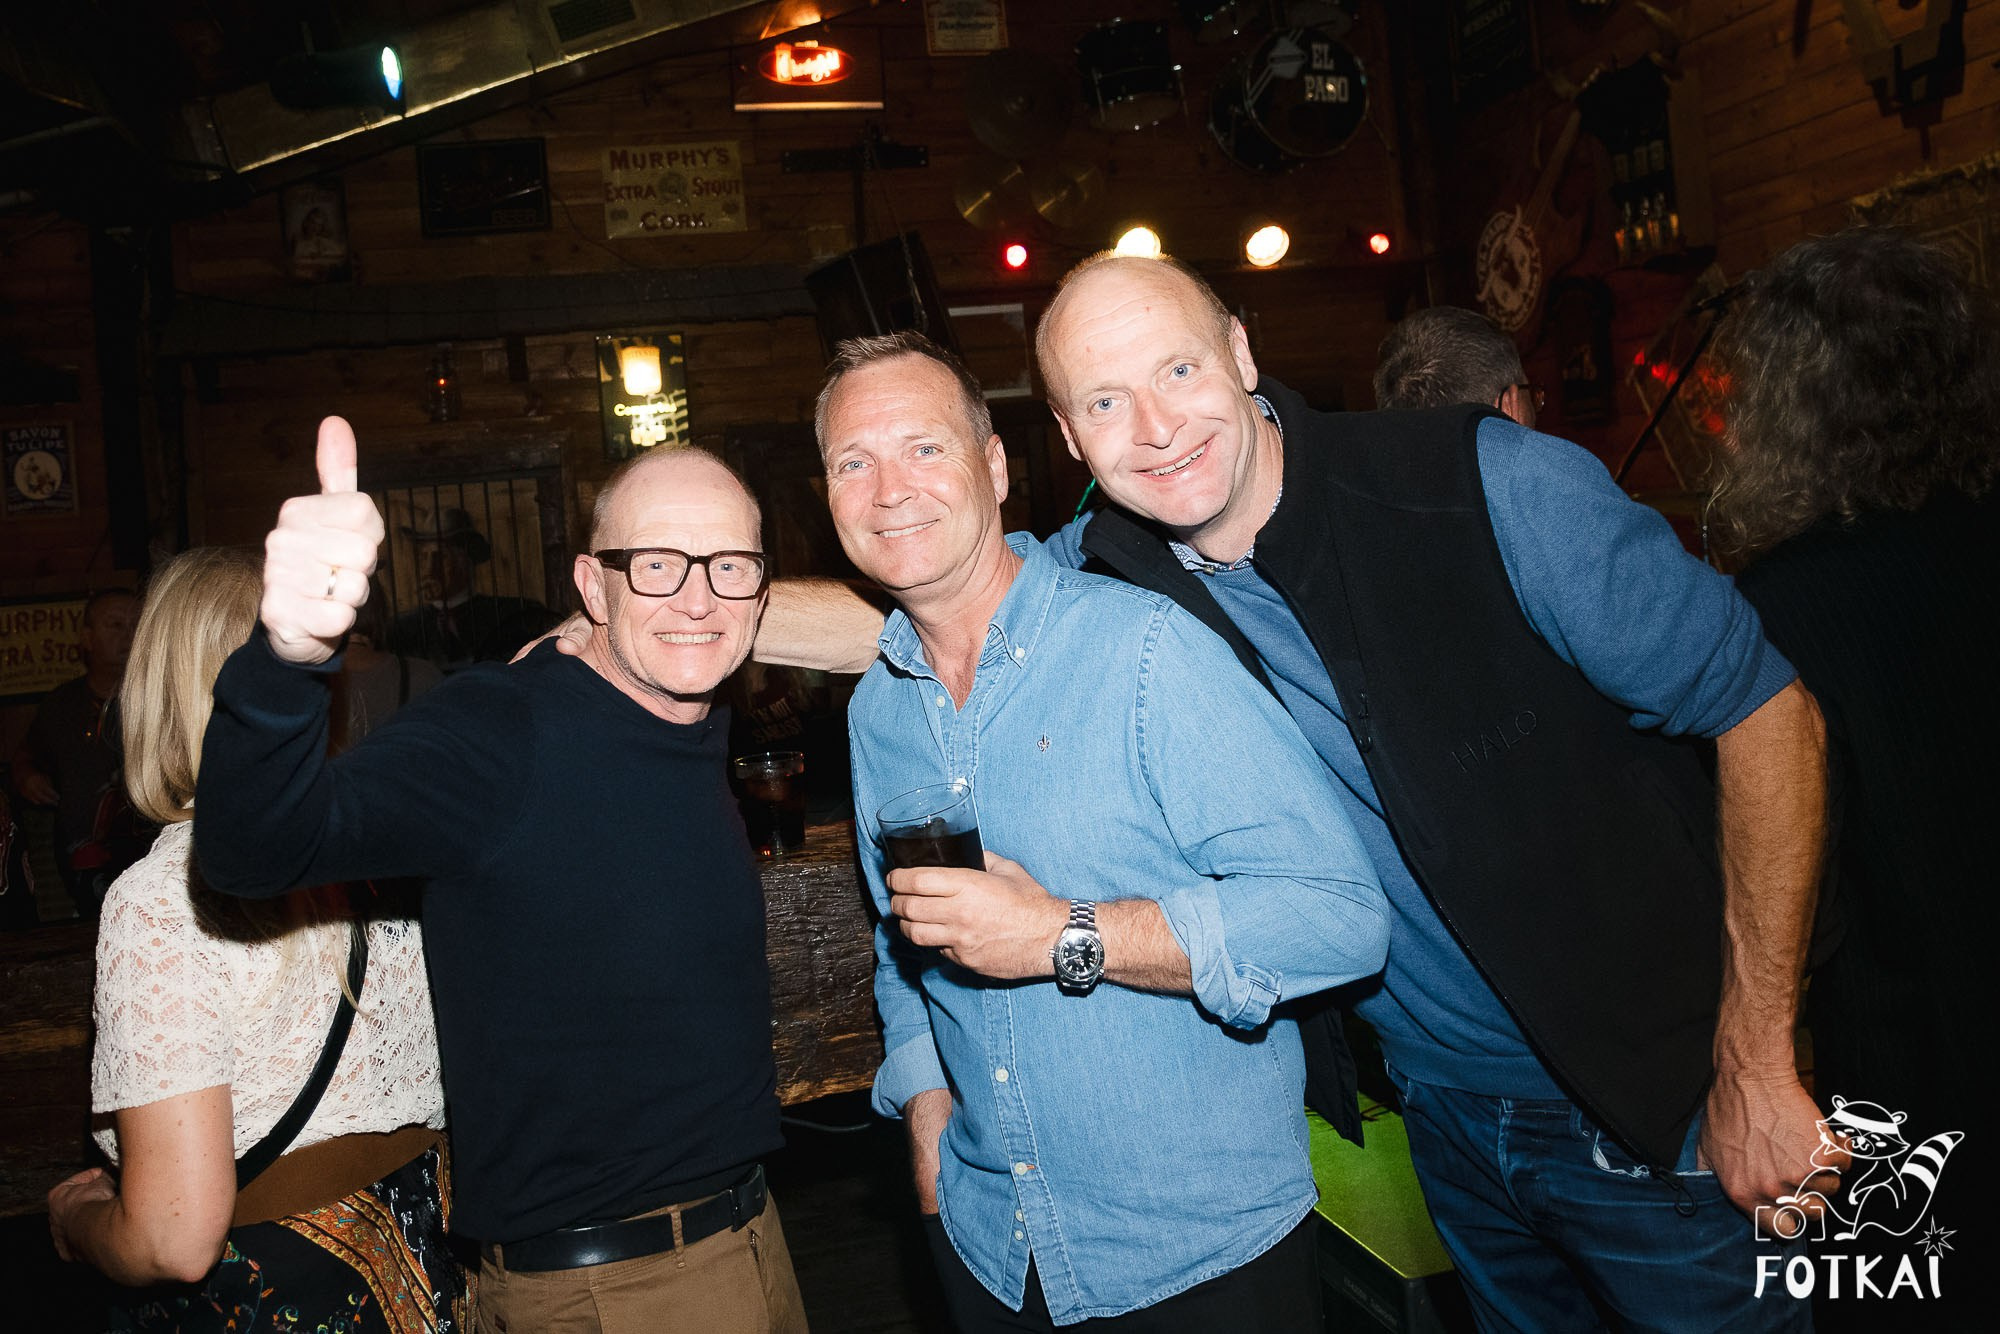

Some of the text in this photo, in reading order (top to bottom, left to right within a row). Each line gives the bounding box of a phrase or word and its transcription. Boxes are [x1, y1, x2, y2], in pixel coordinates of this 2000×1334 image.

[1311, 42, 1335, 71] EL
[1304, 73, 1350, 103] PASO
[609, 147, 730, 171] MURPHY'S
[604, 176, 740, 203] EXTRA STOUT
[0, 608, 83, 637] URPHY
[0, 638, 81, 667] TRA STO
[1452, 710, 1537, 773] HALO
